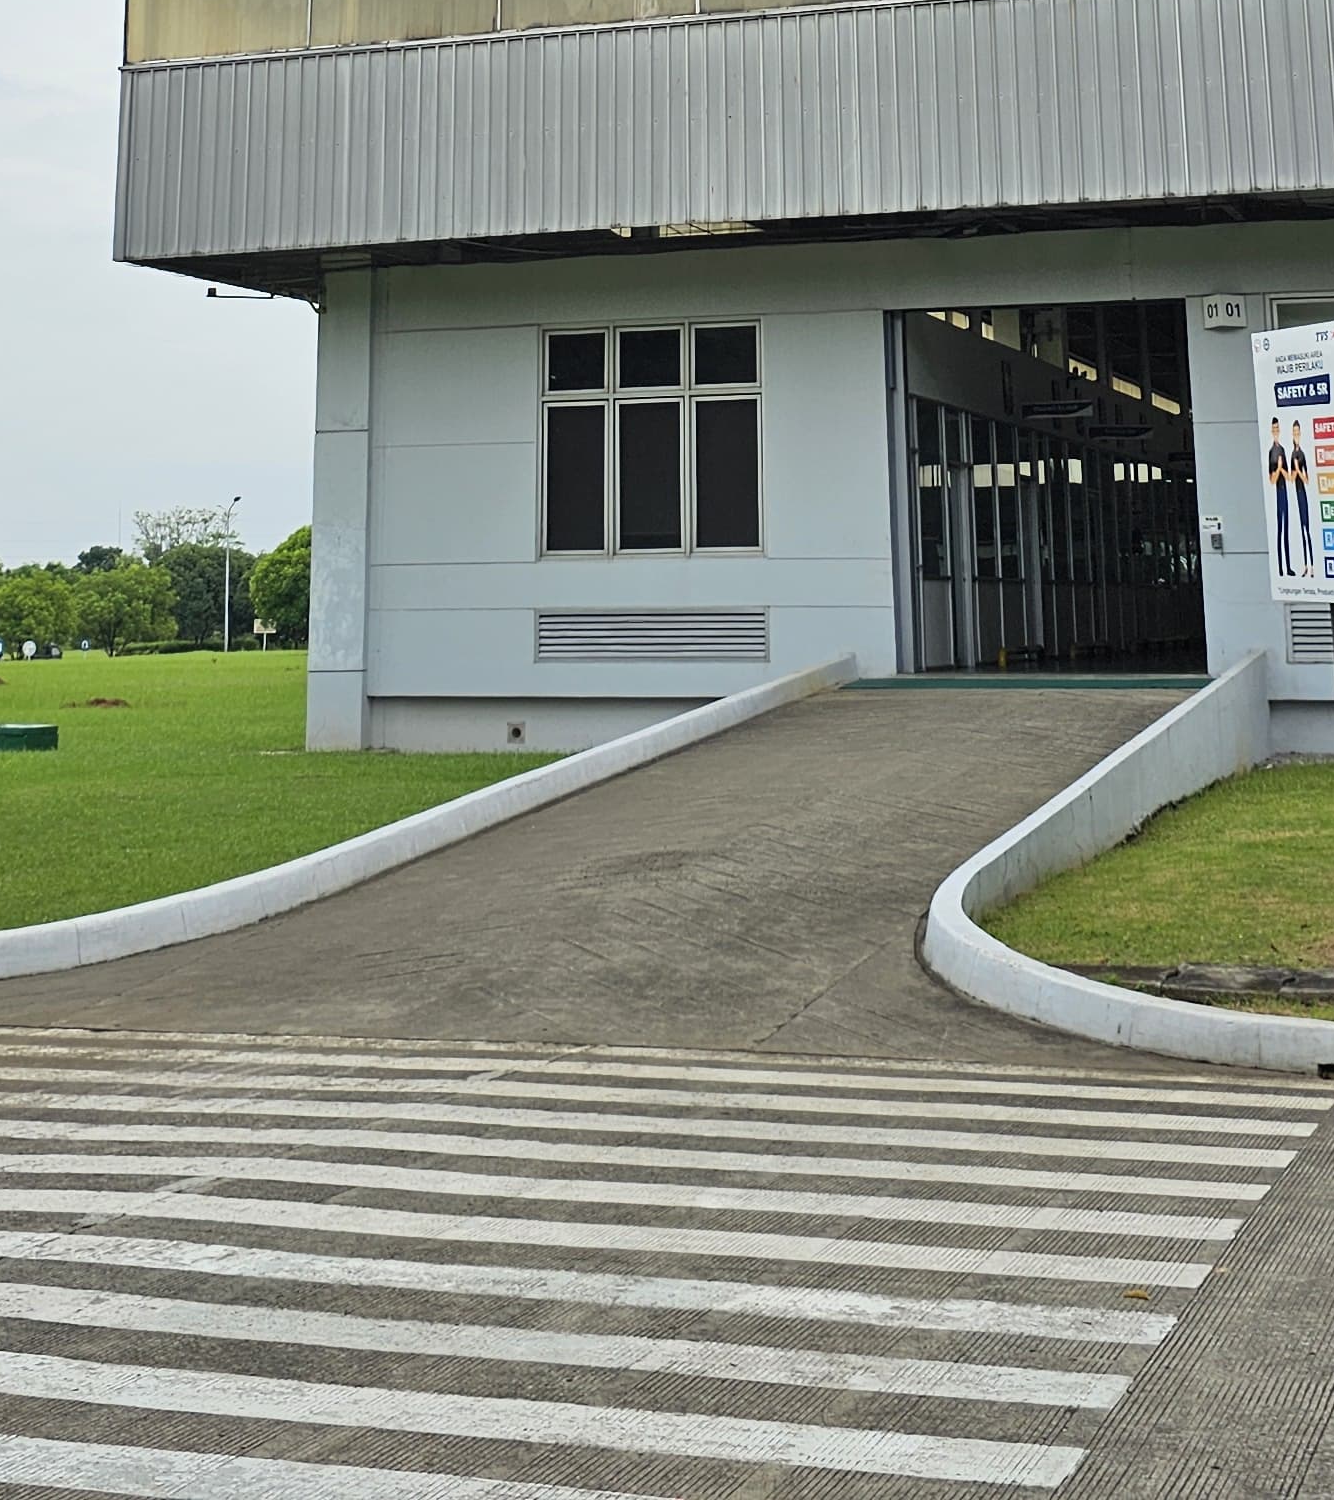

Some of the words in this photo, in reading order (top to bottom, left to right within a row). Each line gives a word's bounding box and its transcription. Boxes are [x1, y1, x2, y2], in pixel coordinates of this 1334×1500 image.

[1207, 303, 1219, 318] 01
[1226, 302, 1241, 318] 01
[1315, 331, 1329, 342] TVS
[1276, 364, 1294, 375] WAJIB
[1294, 360, 1324, 372] PERILAKU
[1277, 384, 1307, 399] SAFETY
[1309, 384, 1316, 396] &
[1317, 382, 1329, 396] 5R
